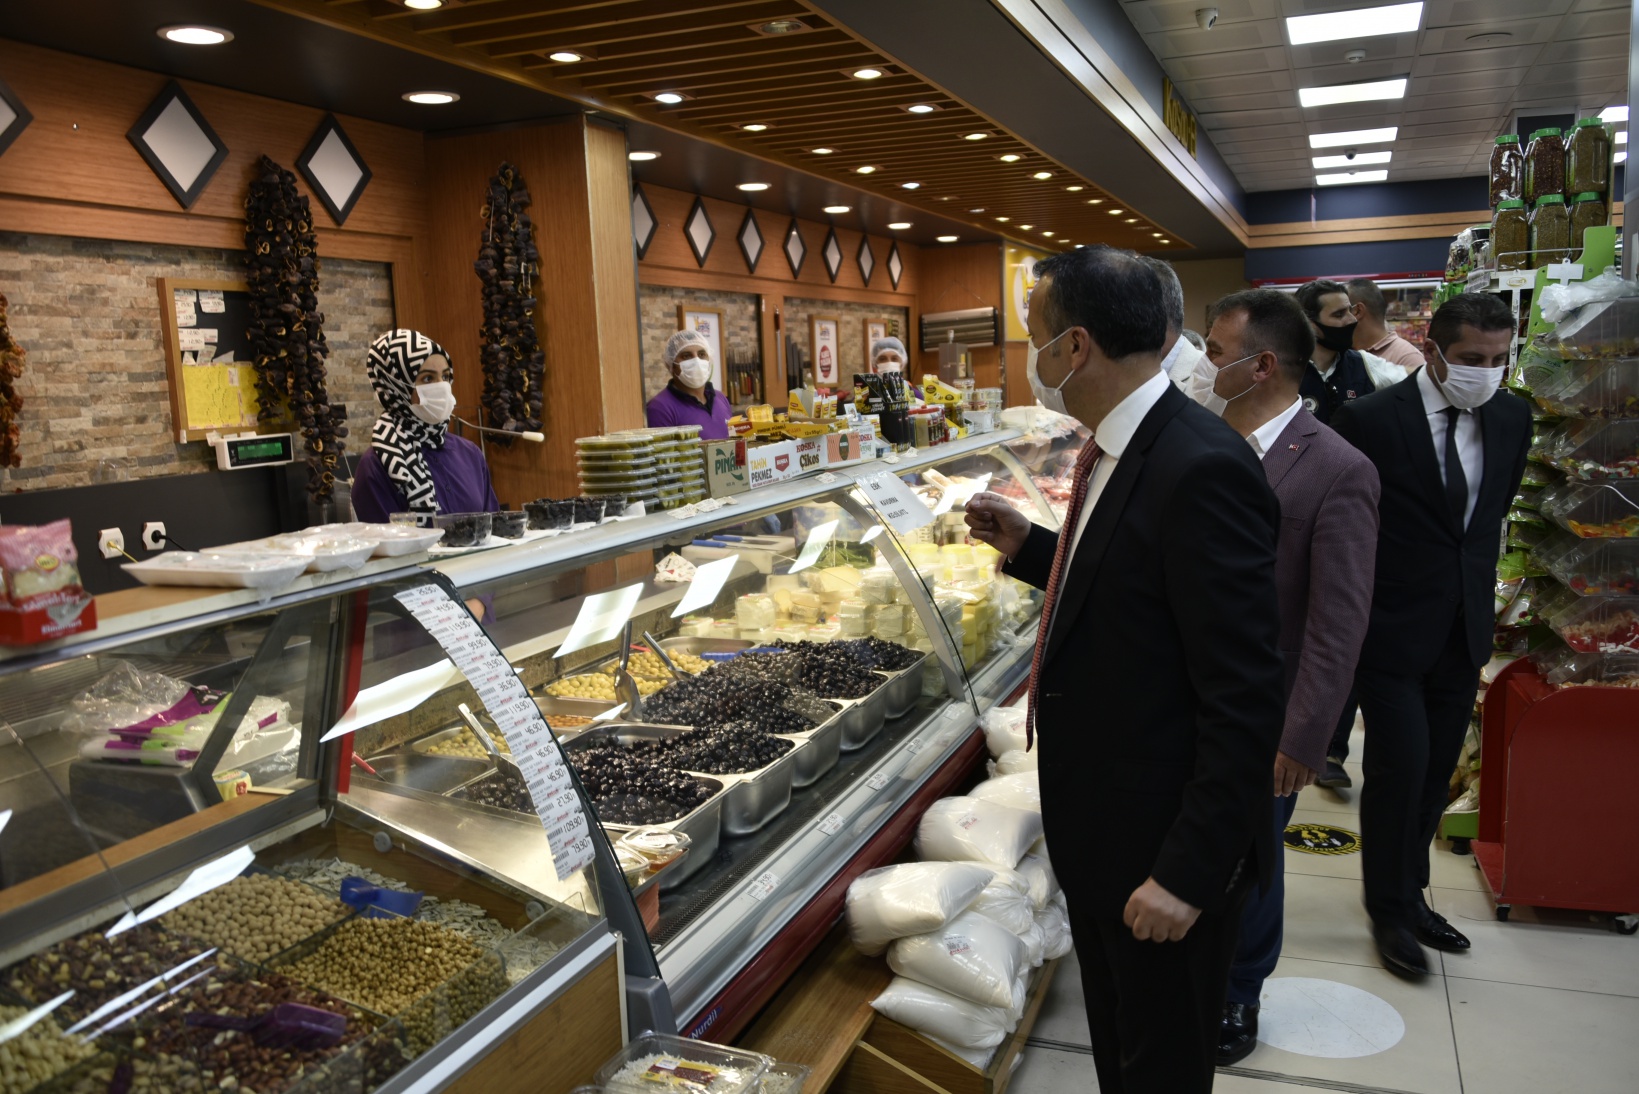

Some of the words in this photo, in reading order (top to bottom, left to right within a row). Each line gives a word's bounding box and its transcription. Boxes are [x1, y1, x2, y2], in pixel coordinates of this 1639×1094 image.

[796, 441, 816, 453] KOSKA
[751, 468, 773, 483] PEKMEZ
[691, 1009, 718, 1040] Nurdil
